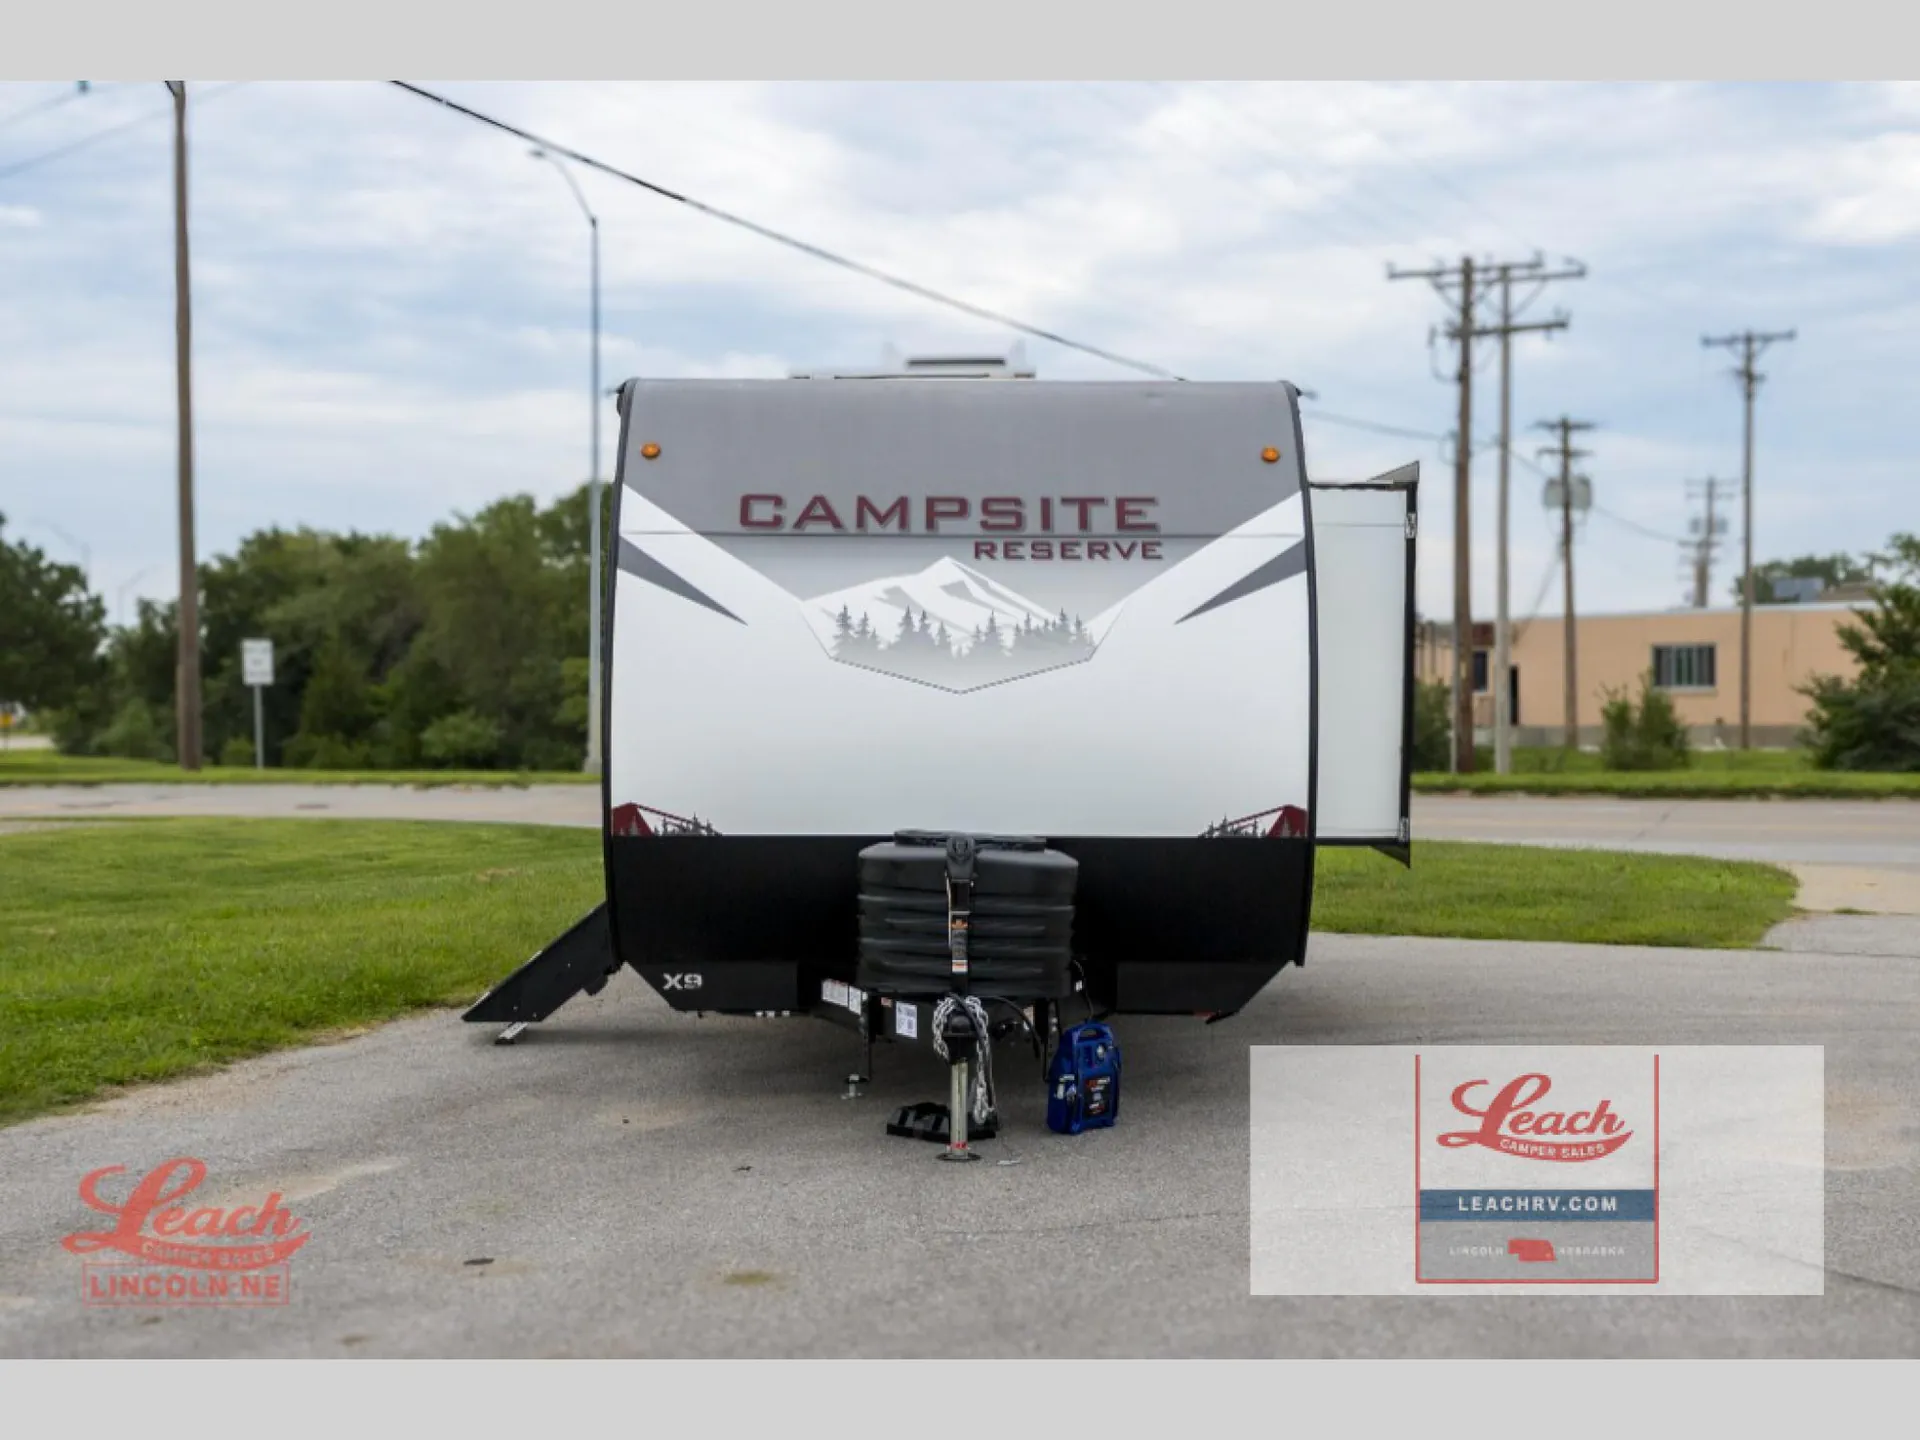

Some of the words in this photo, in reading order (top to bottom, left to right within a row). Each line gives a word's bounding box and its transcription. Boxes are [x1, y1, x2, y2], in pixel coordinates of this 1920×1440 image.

[739, 493, 1160, 534] CAMPSITE
[973, 540, 1163, 561] RESERVE
[662, 972, 704, 991] X9
